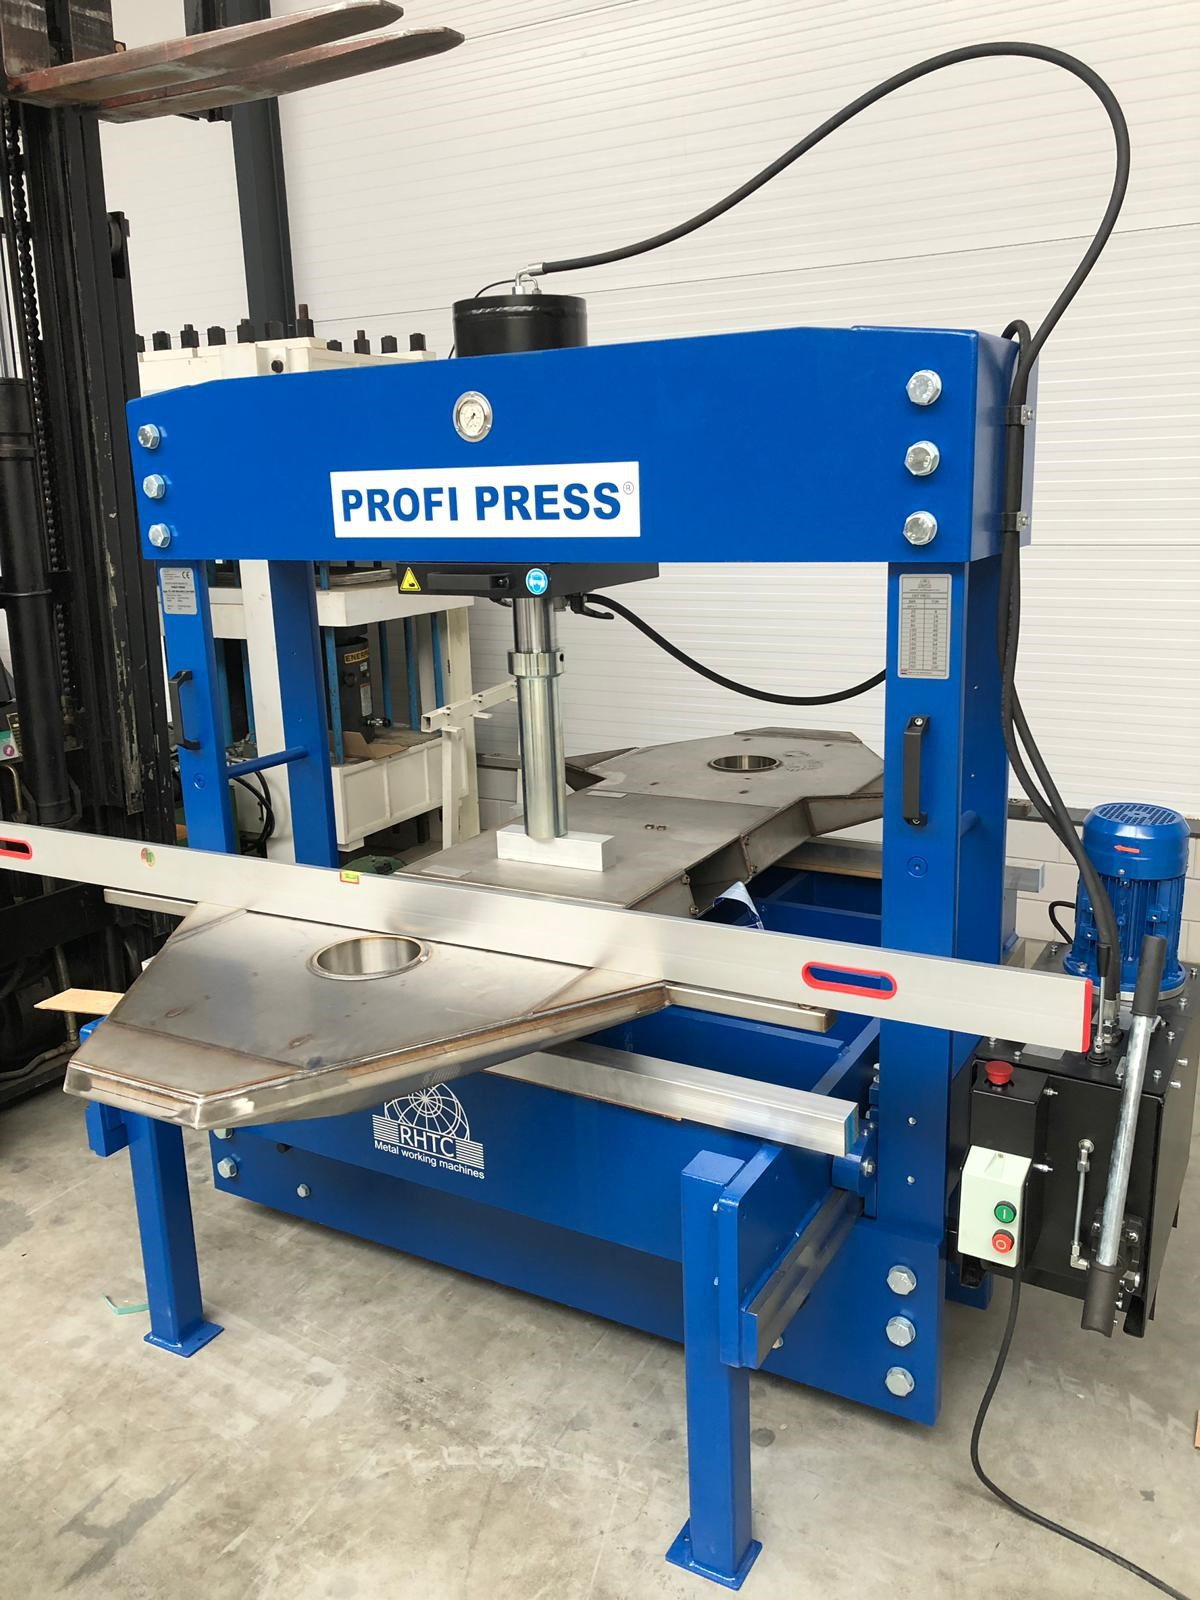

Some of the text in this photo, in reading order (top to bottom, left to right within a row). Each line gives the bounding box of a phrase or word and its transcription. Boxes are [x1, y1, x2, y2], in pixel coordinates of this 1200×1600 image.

[341, 487, 458, 522] PROFI
[475, 482, 621, 521] PRESS
[374, 1140, 485, 1179] Metal working machines
[400, 1125, 454, 1157] RHTC
